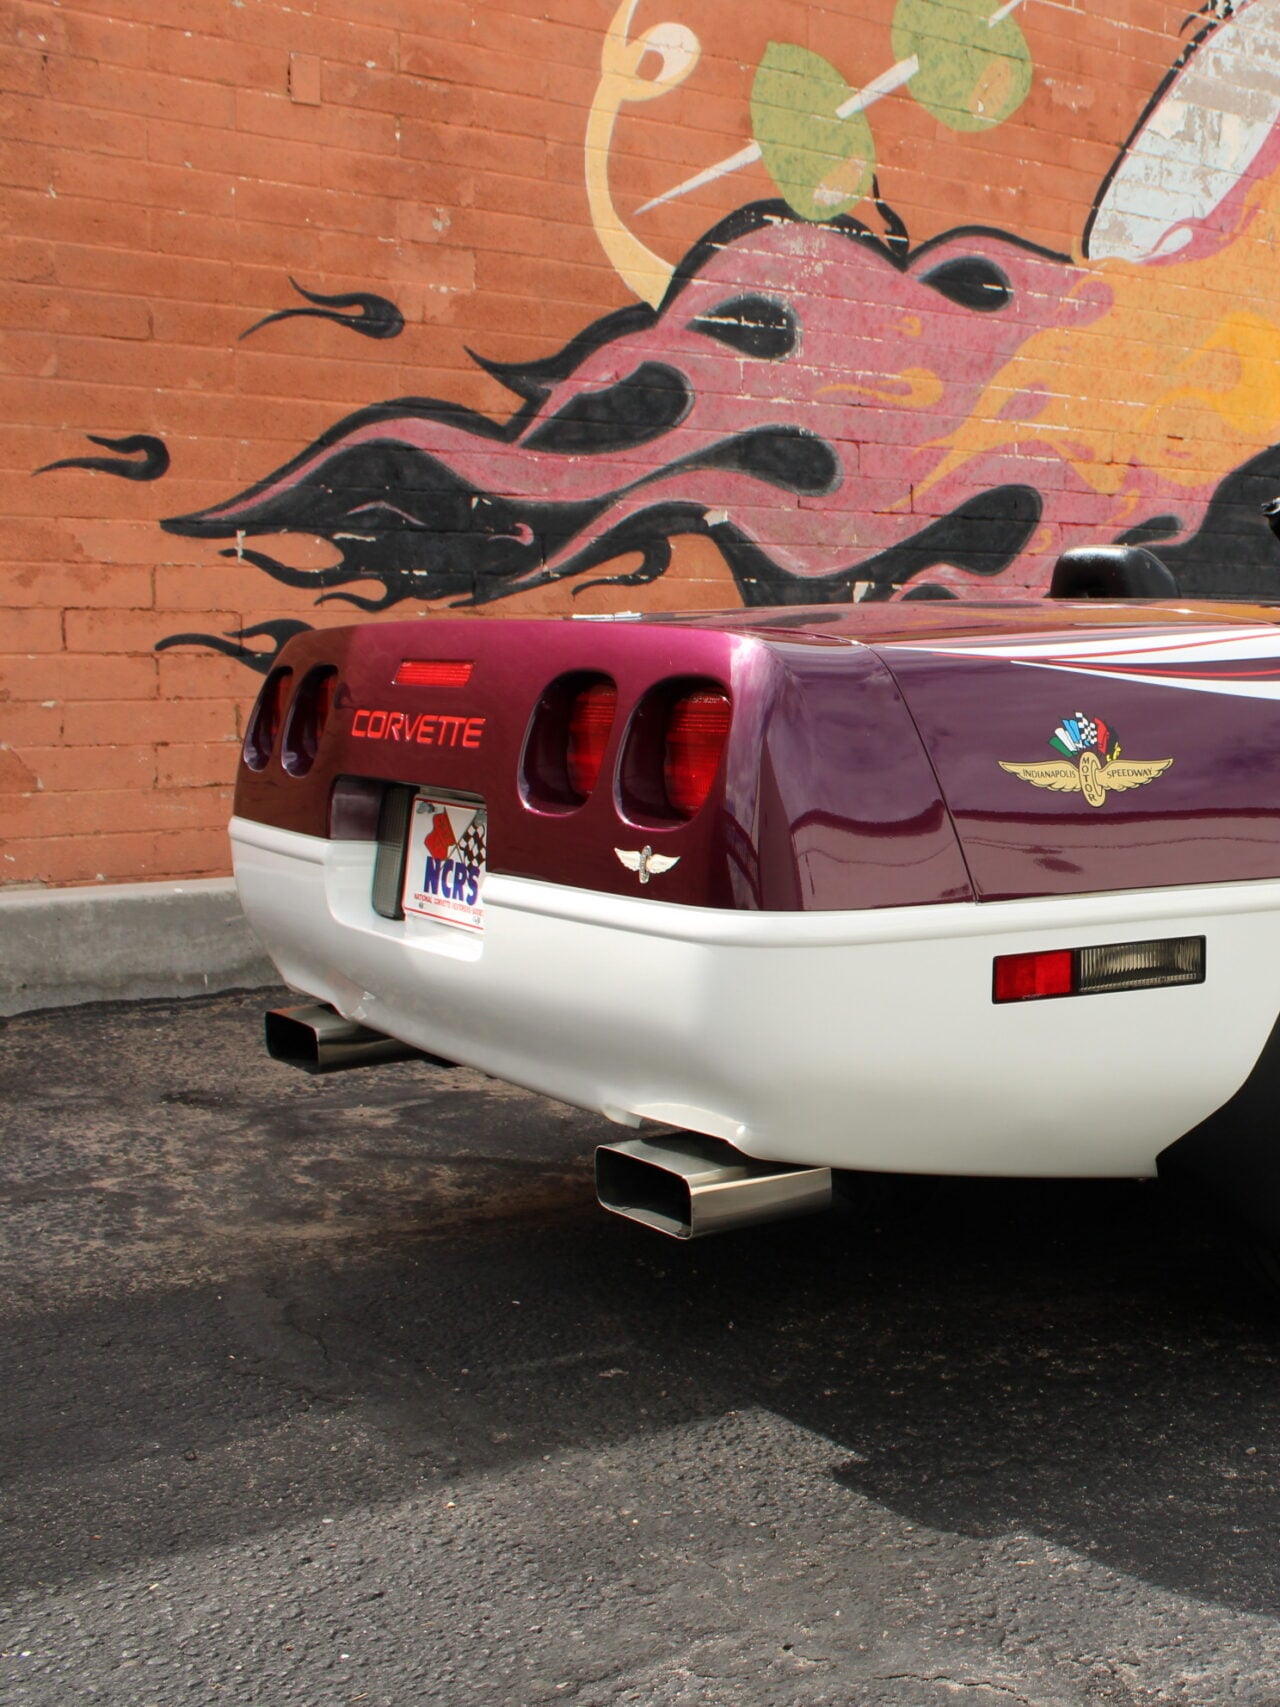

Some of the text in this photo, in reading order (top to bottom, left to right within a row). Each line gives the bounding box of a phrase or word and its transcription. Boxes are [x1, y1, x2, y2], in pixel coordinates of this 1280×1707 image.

[351, 709, 486, 748] CORVETTE
[1022, 769, 1077, 778] INDIANAPOLIS
[1081, 757, 1097, 801] MOTOR
[1106, 768, 1153, 779] SPEEDWAY
[423, 855, 480, 906] NCRS
